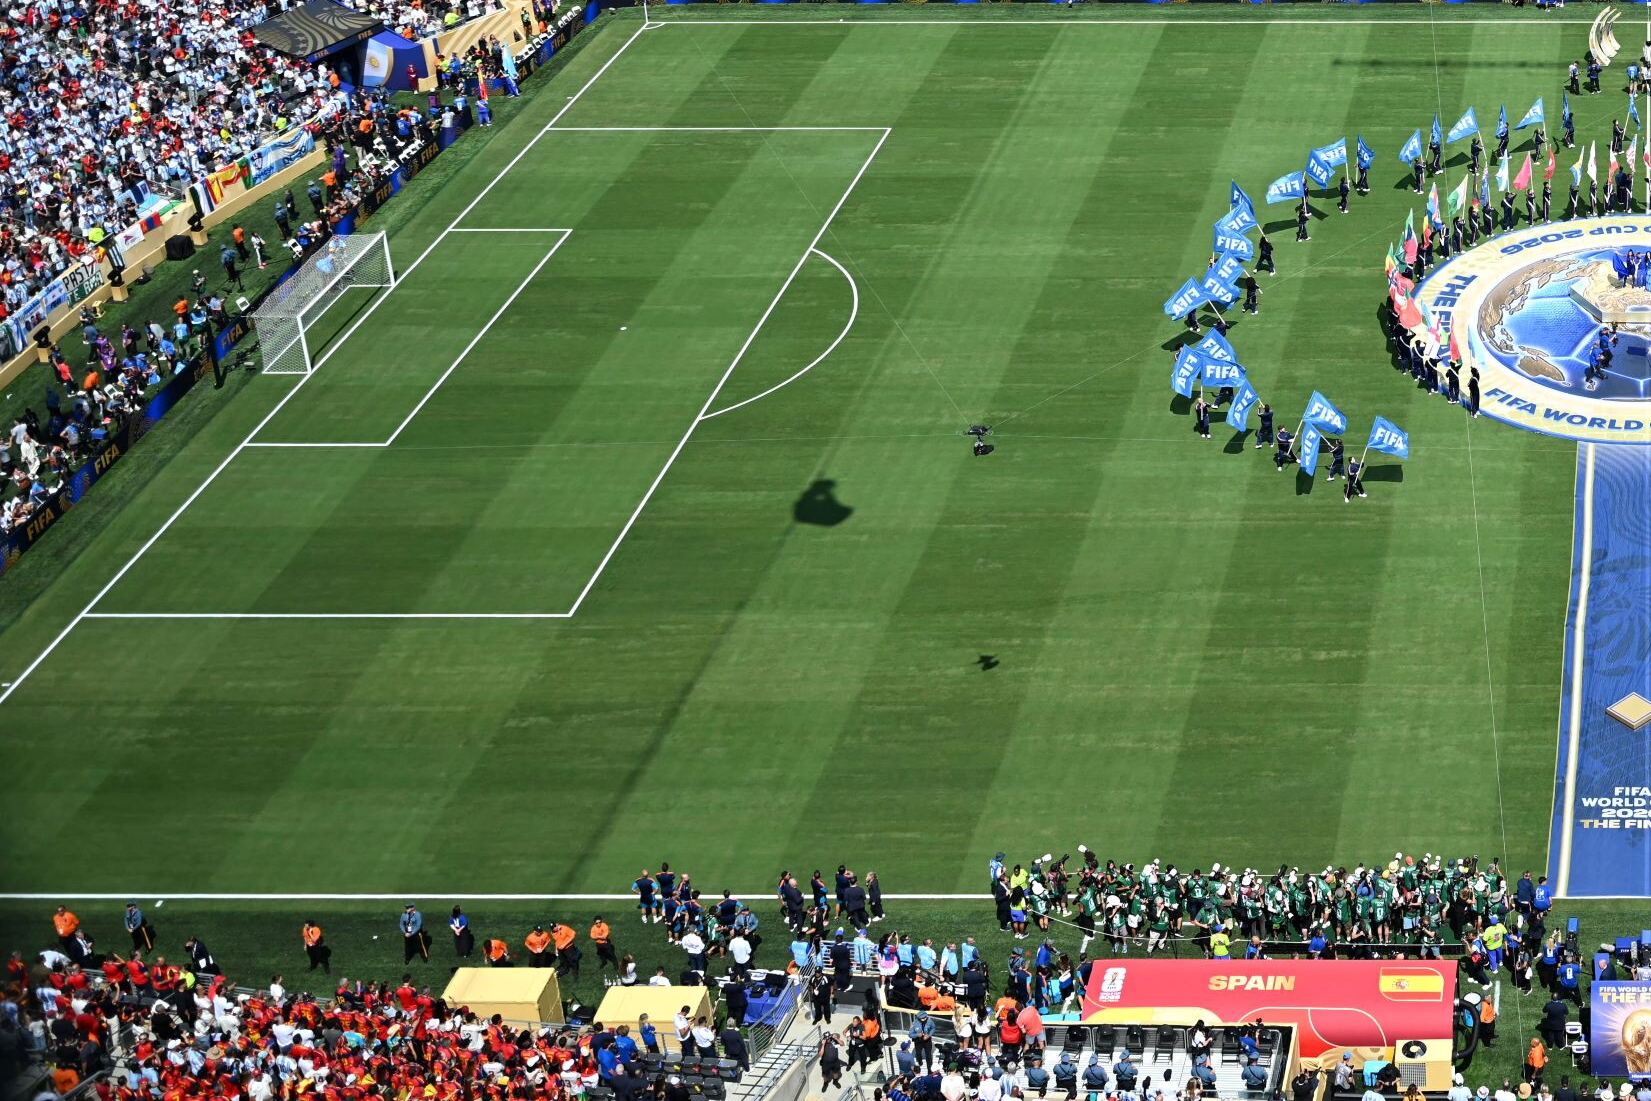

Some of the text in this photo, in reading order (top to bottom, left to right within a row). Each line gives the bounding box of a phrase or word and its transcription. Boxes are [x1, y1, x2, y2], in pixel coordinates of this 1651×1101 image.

[358, 29, 373, 40] FIFA
[550, 33, 566, 52] FIFA
[315, 49, 330, 60] FIFA
[420, 140, 439, 165] FIFA
[1309, 157, 1328, 183] FIFA
[375, 183, 394, 203] FIFA
[1588, 224, 1638, 237] CUP
[1217, 235, 1248, 252] FIFA
[1500, 228, 1584, 256] 2026
[1204, 277, 1233, 303] FIFA
[1431, 274, 1477, 309] THE
[220, 323, 244, 352] FIFA
[1206, 365, 1240, 379] FIFA
[1312, 402, 1342, 428] FIFA
[1484, 387, 1537, 419] FIFA
[1543, 409, 1644, 431] WORLD
[1375, 428, 1405, 450] FIFA
[94, 443, 120, 475] FIFA
[26, 508, 55, 542] FIFA
[1614, 786, 1651, 797] FIFA
[1581, 798, 1648, 808] WORLD
[1580, 819, 1621, 829] THE
[1208, 975, 1295, 992] SPAIN
[1599, 993, 1636, 1004] THE
